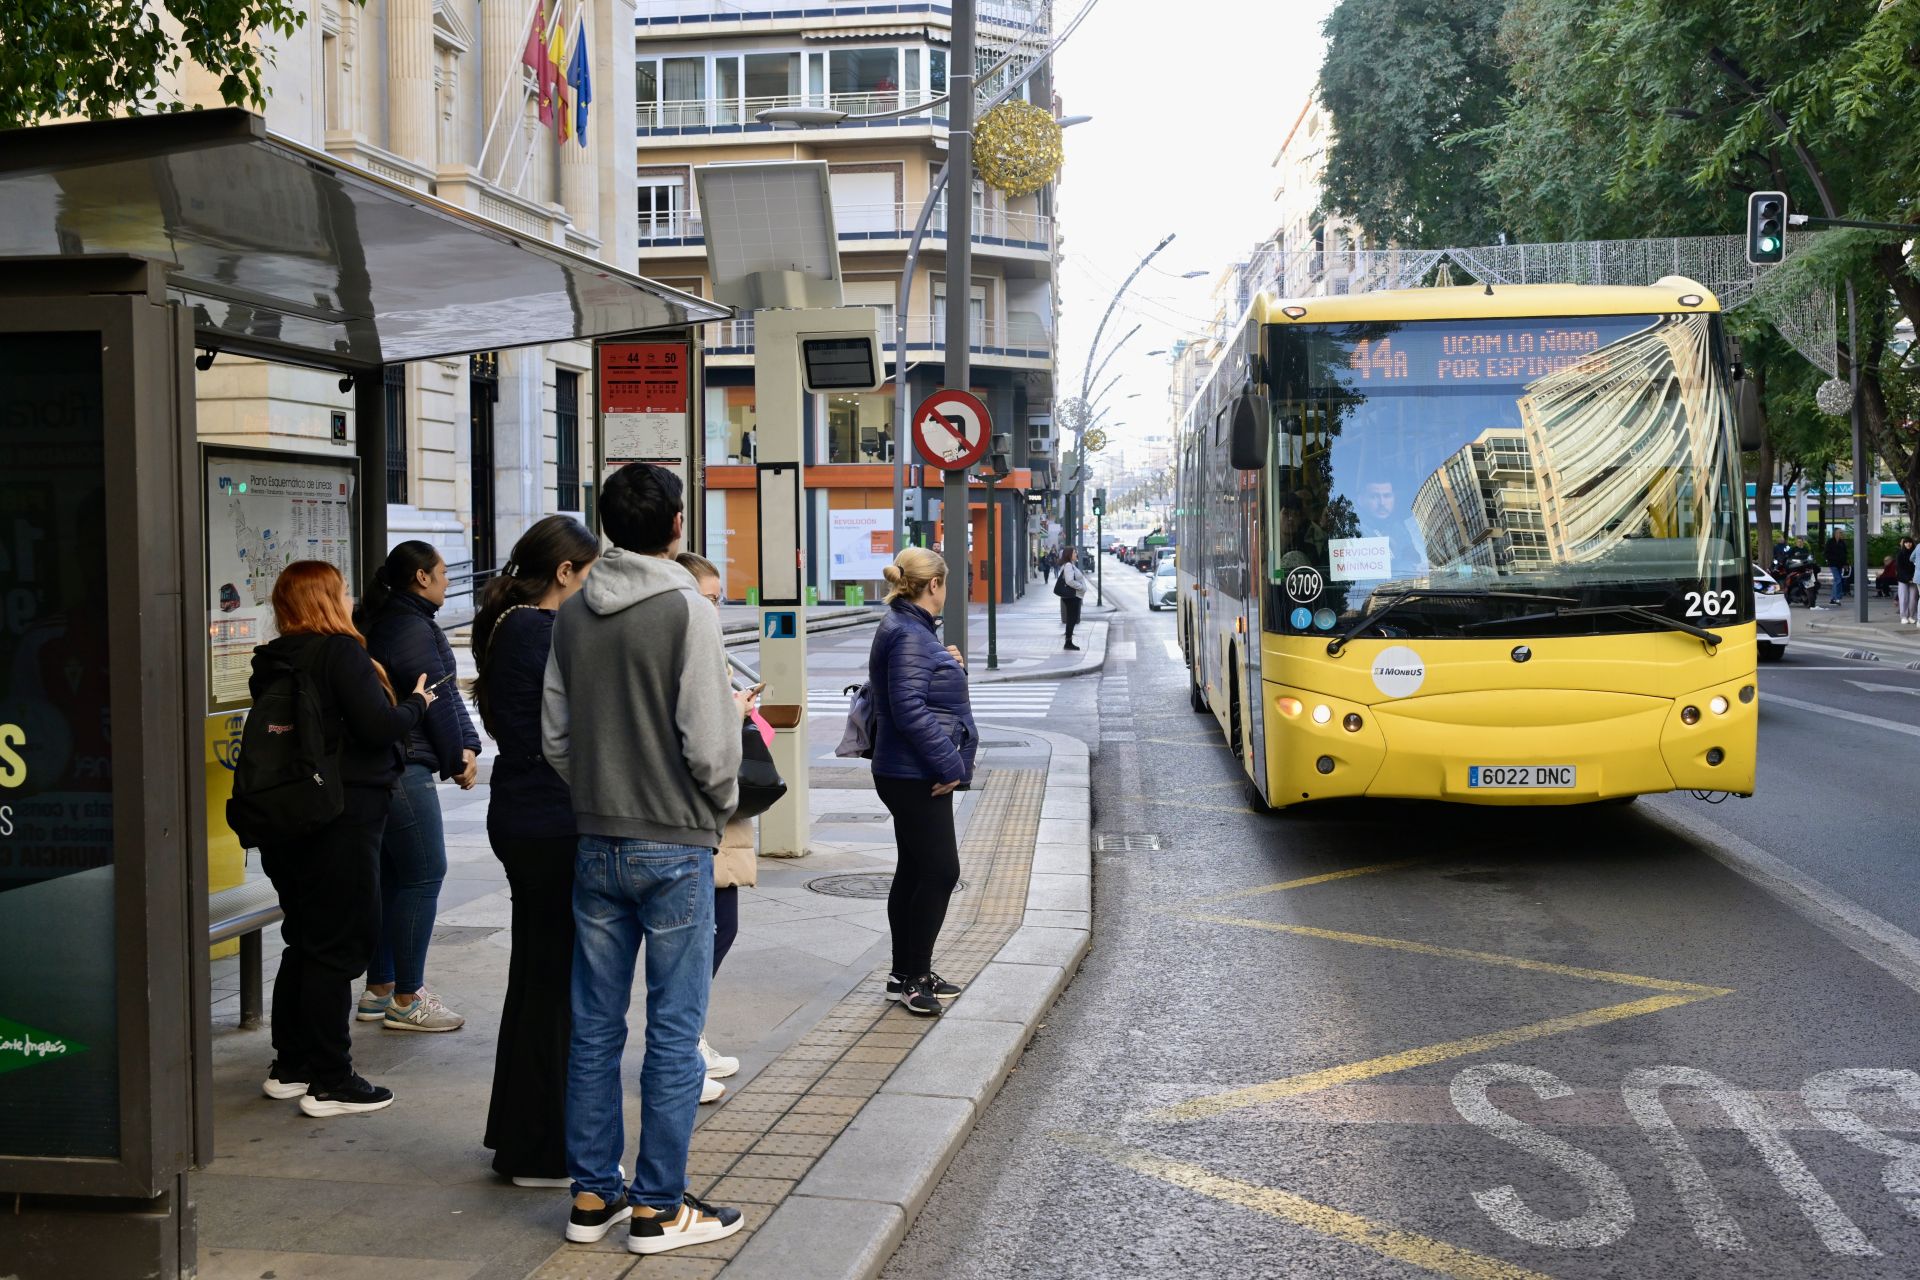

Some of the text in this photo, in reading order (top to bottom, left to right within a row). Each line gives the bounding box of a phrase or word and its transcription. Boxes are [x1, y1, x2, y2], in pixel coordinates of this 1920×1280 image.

[1443, 330, 1599, 355] UCAM LA ÑORA
[628, 352, 639, 364] 44
[664, 352, 676, 363] 50
[1351, 338, 1408, 379] 44A
[1438, 354, 1607, 379] POR ESPINA
[1333, 546, 1385, 558] SERVICIOS
[1336, 561, 1384, 572] MÍNIMOS
[1290, 573, 1319, 596] 3709
[1684, 590, 1737, 617] 262
[1482, 768, 1529, 785] 6022
[1536, 768, 1571, 785] DNC
